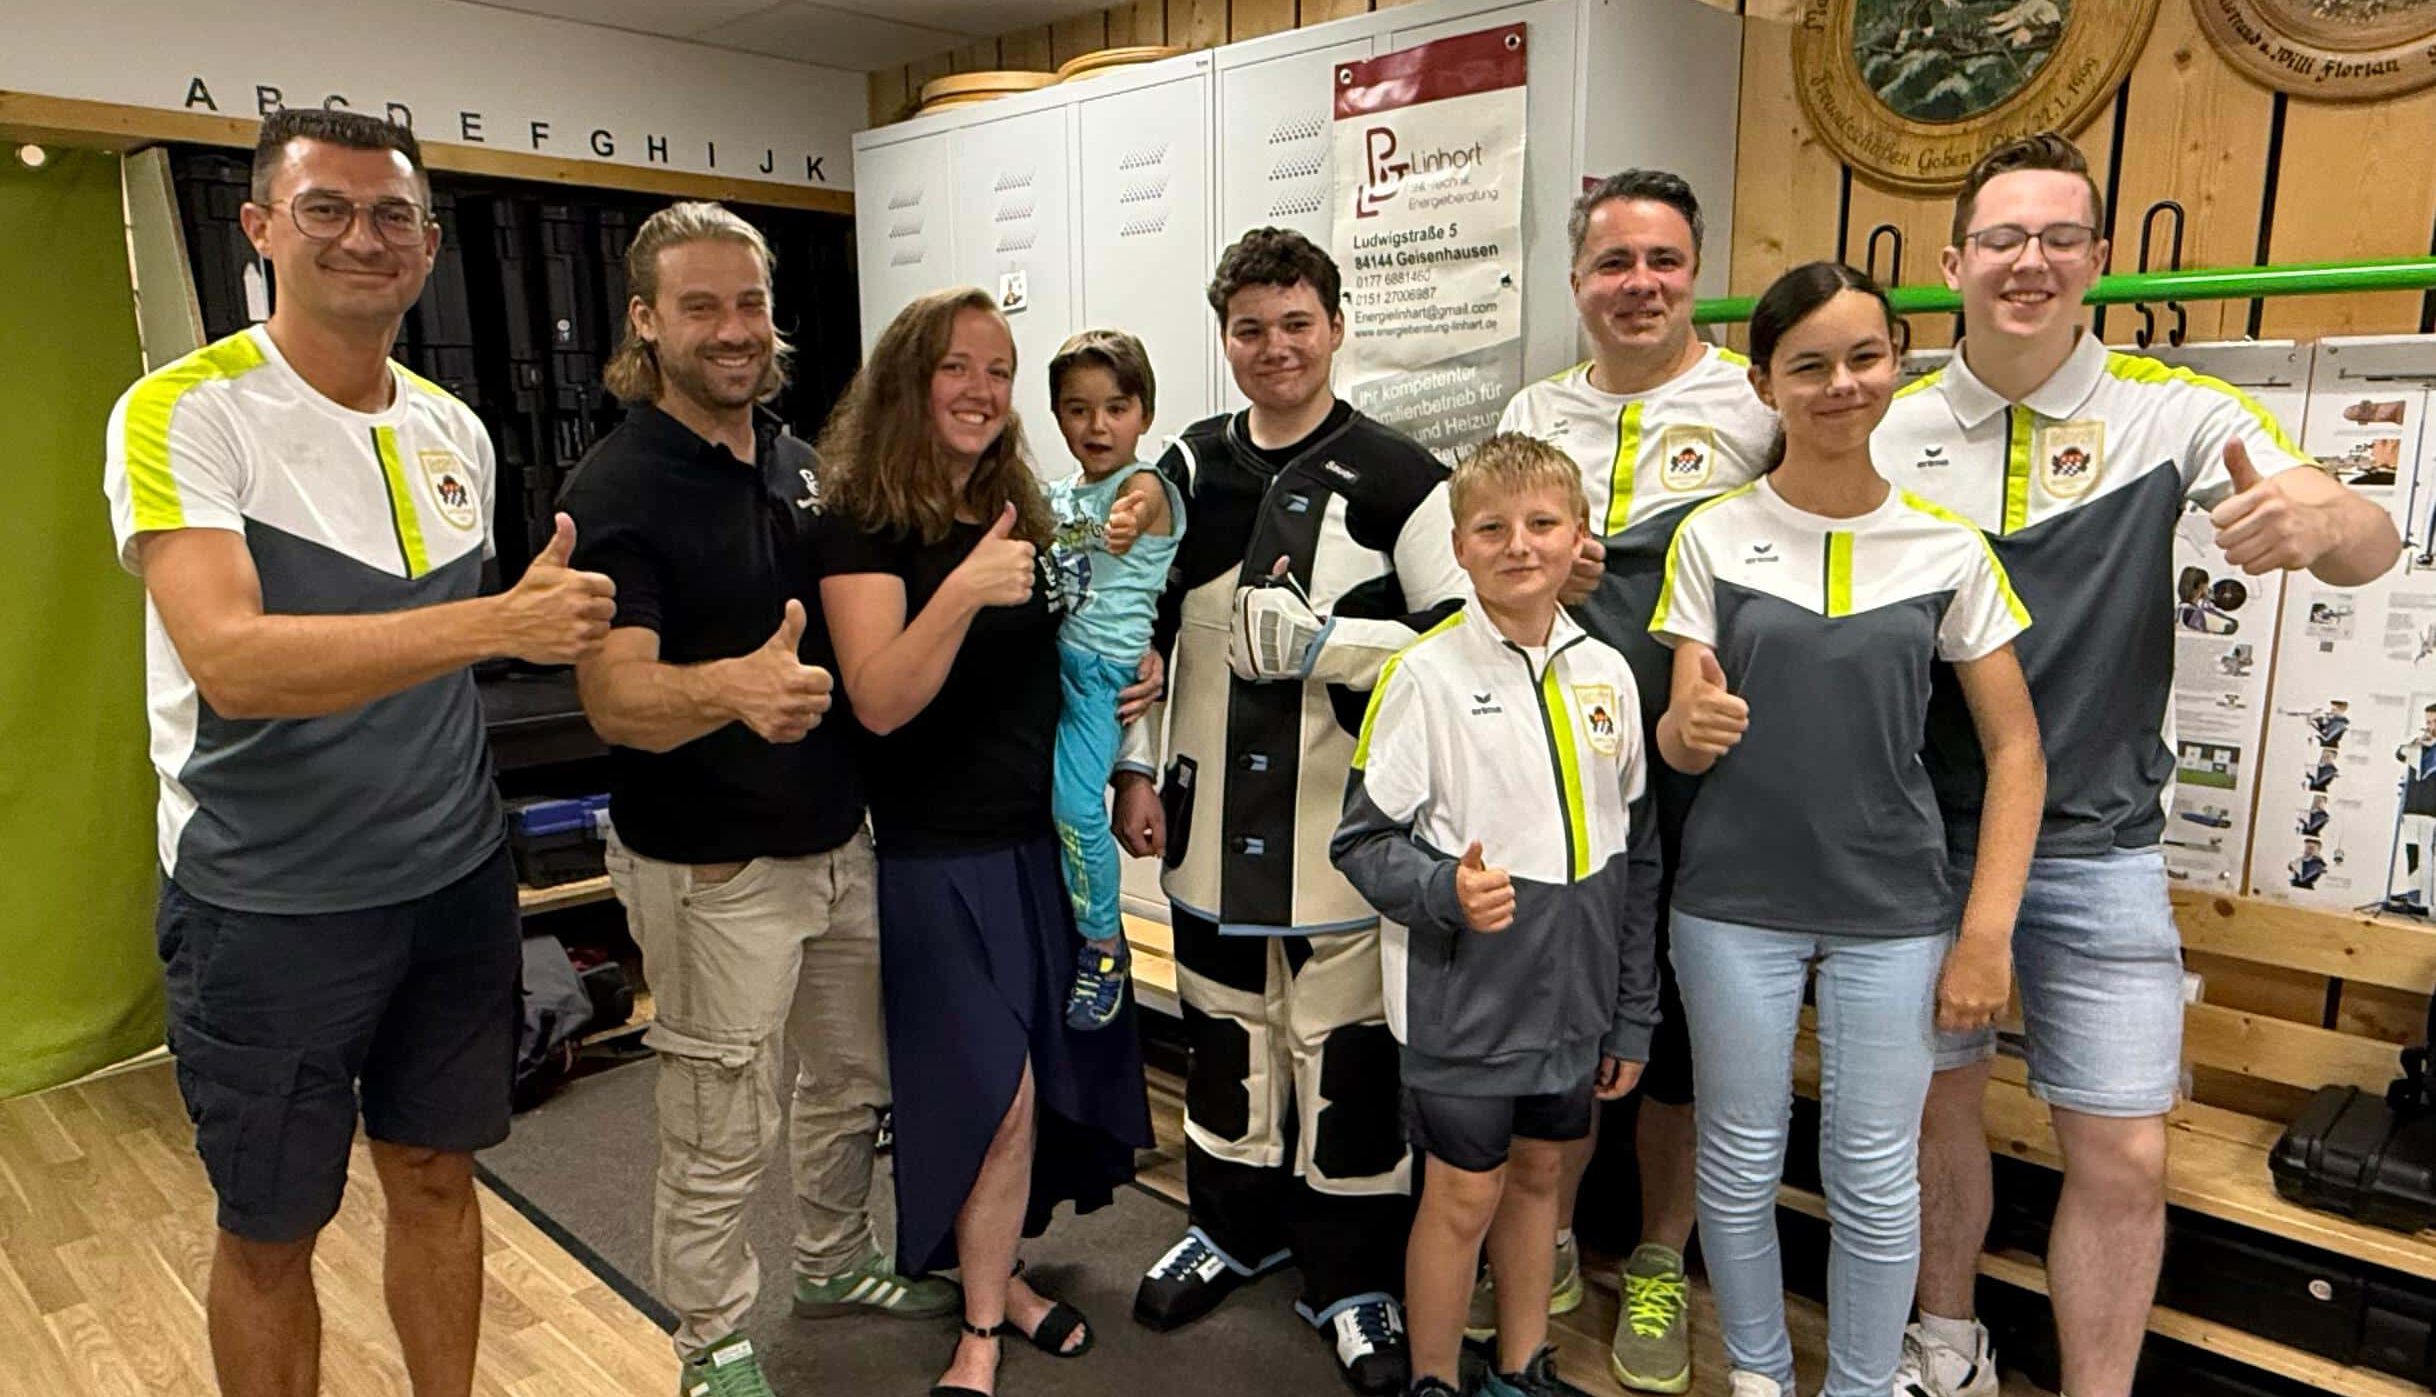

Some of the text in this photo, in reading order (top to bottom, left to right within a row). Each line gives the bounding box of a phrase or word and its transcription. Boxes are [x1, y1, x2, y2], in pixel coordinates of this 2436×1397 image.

[185, 77, 218, 111] A
[459, 111, 484, 142] E
[530, 121, 550, 150] F
[590, 129, 614, 158] G
[647, 135, 669, 164] H
[707, 141, 716, 168] I
[759, 149, 774, 174] J
[806, 155, 826, 182] K
[1353, 222, 1458, 250] Ludwigstraße 5
[1354, 243, 1499, 271] 84144 Geisenhausen
[1356, 273, 1383, 289] 0177
[1355, 291, 1381, 307] 0151
[1359, 365, 1478, 409] Ihr kompetenter
[1479, 381, 1504, 402] für
